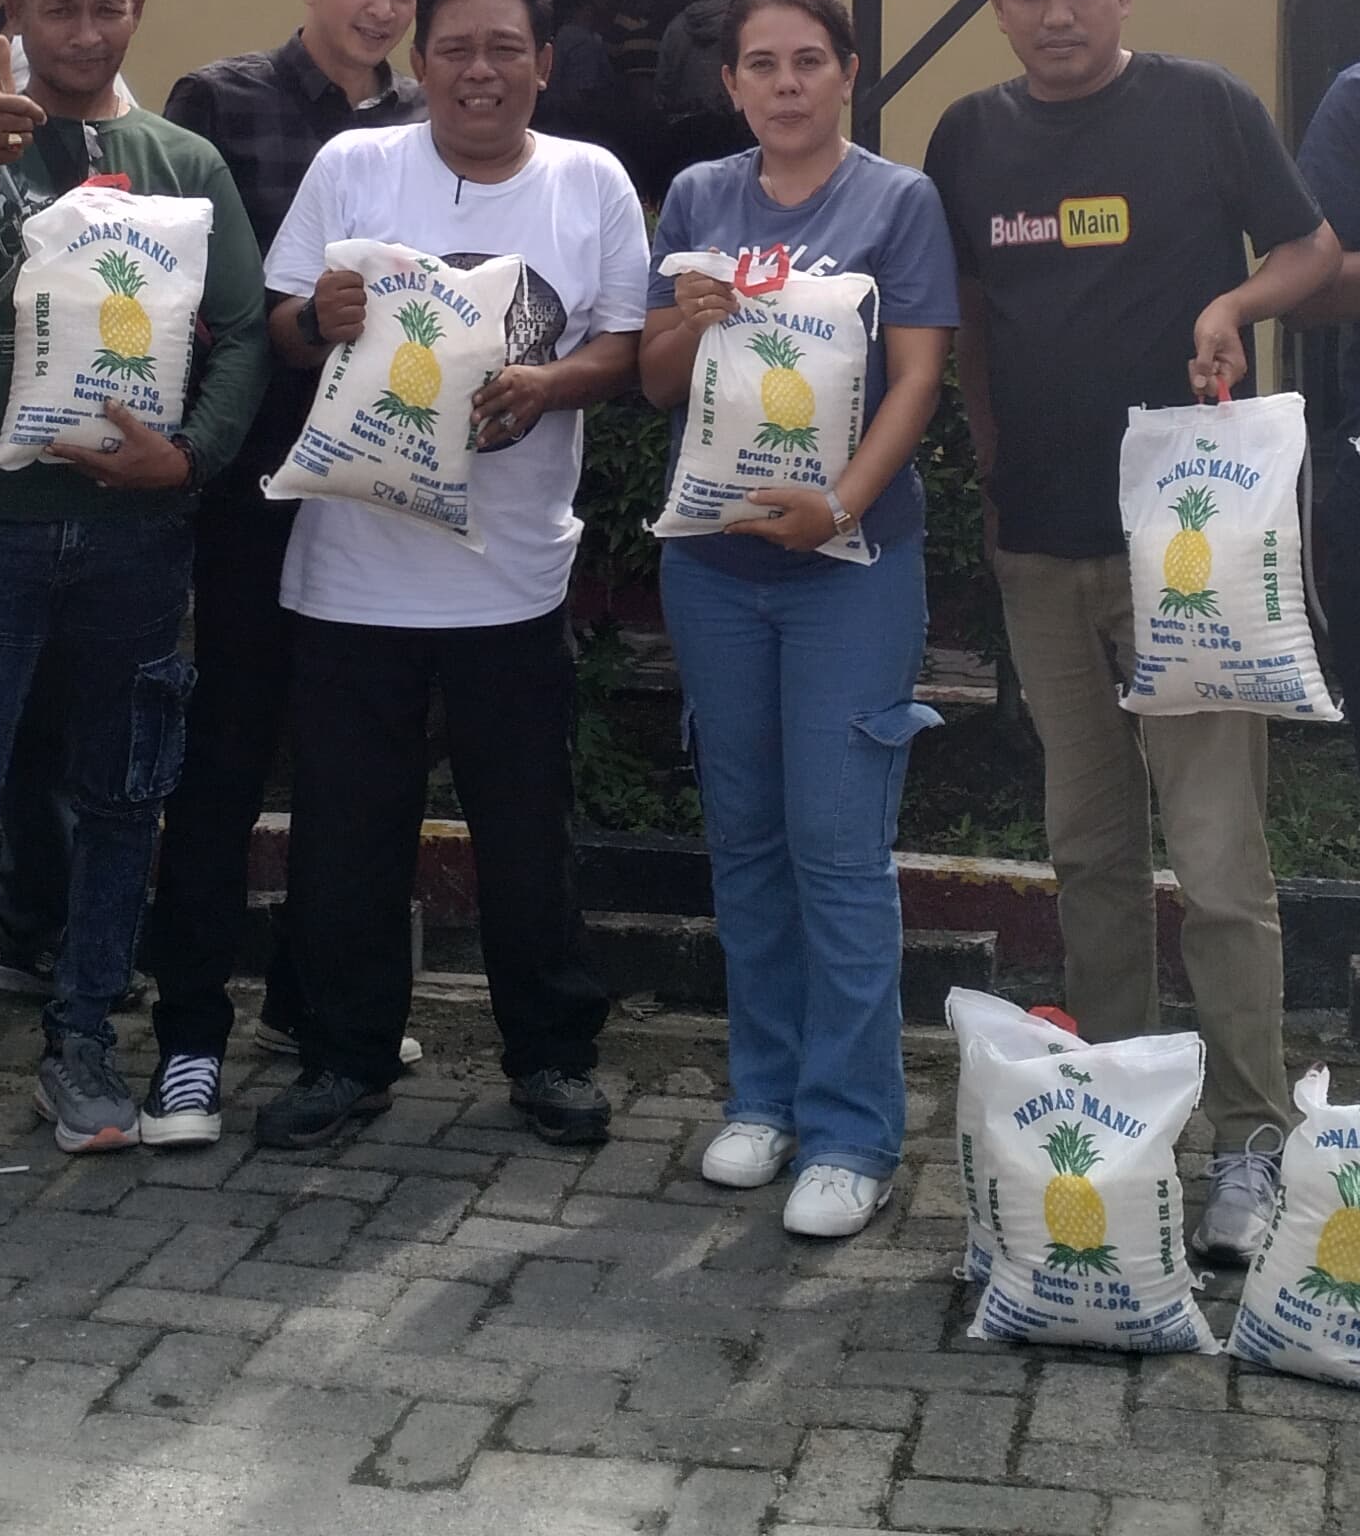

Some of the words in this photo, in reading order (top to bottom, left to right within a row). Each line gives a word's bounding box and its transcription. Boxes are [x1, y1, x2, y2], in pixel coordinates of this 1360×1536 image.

[991, 212, 1058, 247] Bukan
[1068, 208, 1120, 236] Main
[127, 227, 178, 272] MANIS
[36, 292, 50, 338] BERAS
[369, 272, 427, 297] NENAS
[431, 279, 482, 327] MANIS
[516, 322, 546, 330] OUT
[773, 313, 836, 341] MANIS
[37, 340, 49, 356] IR
[1264, 553, 1277, 568] IR
[1264, 573, 1282, 621] BERAS
[1013, 1088, 1074, 1130] NENAS
[1081, 1094, 1147, 1139] MANIS
[1094, 1281, 1103, 1293] 5
[1109, 1280, 1130, 1296] Kg
